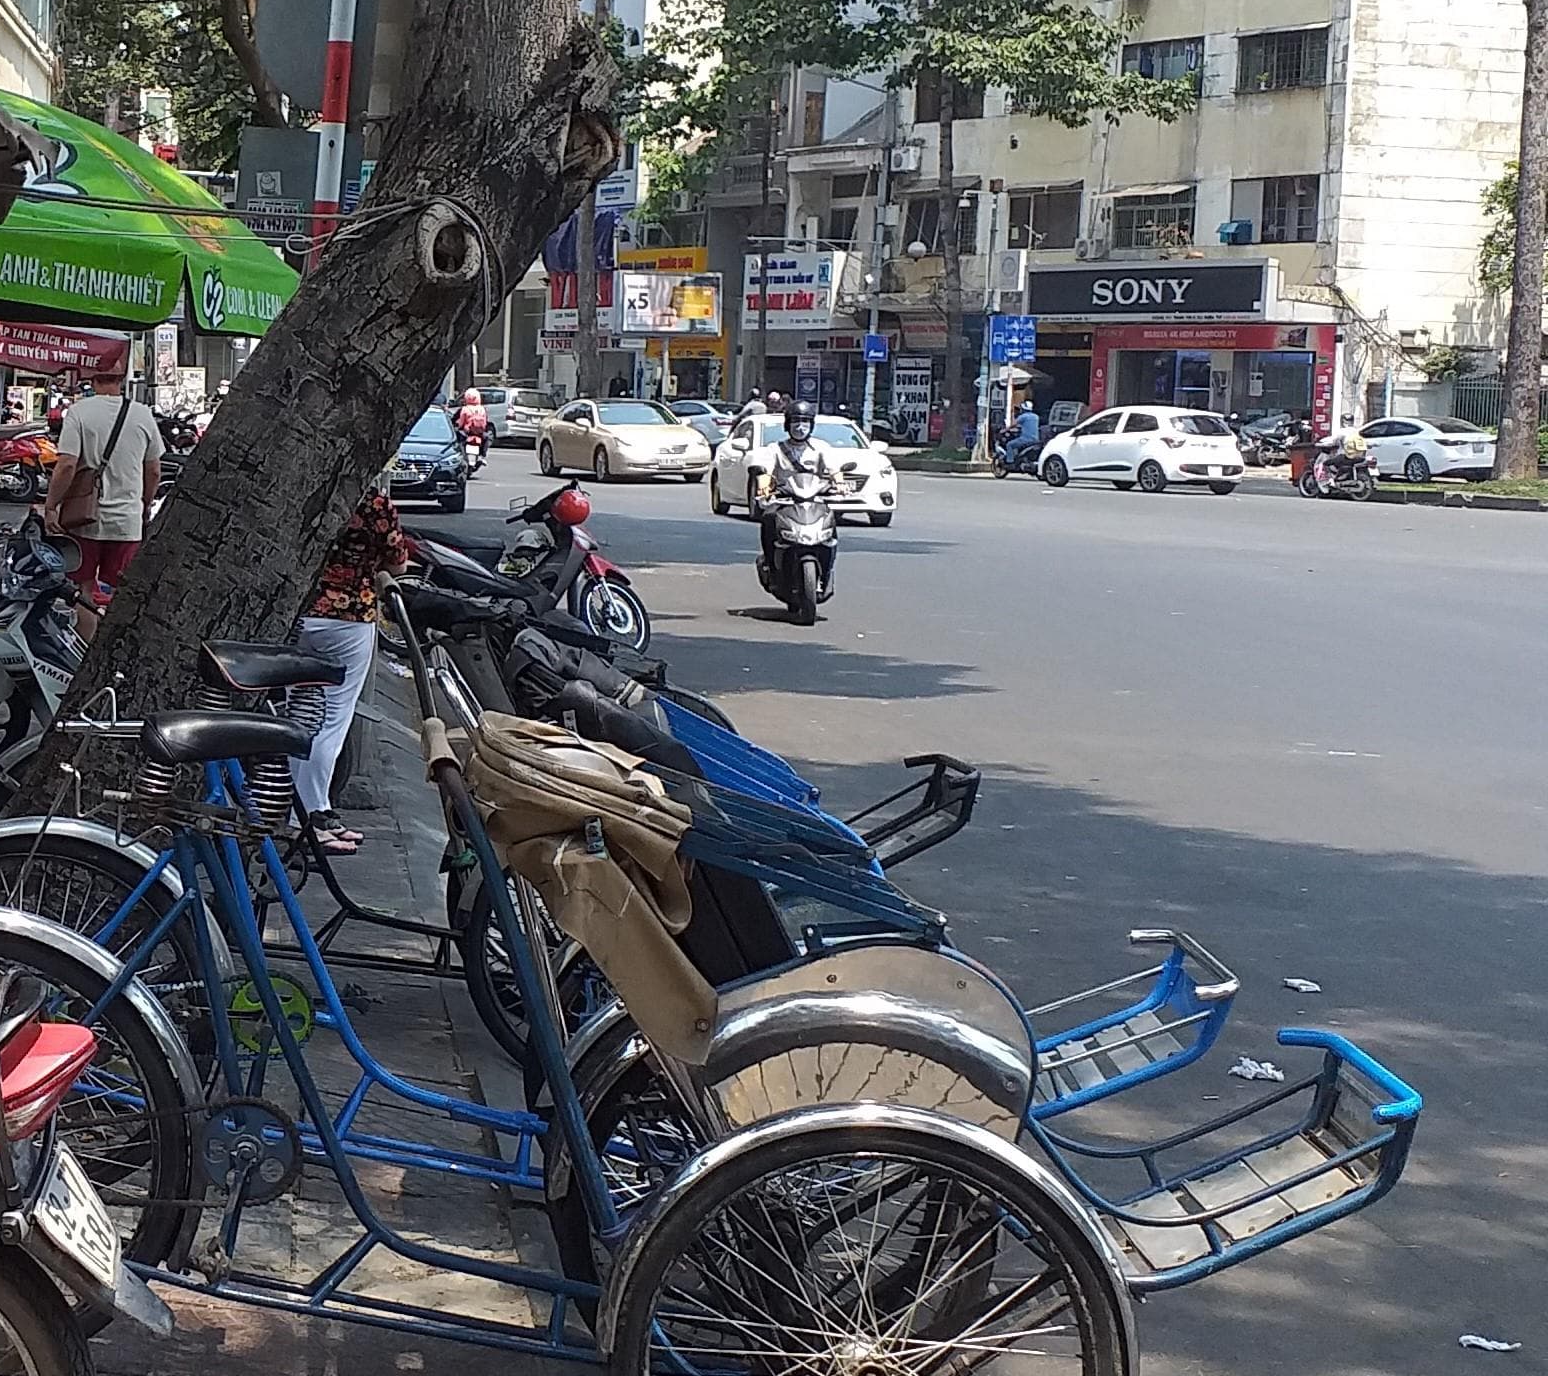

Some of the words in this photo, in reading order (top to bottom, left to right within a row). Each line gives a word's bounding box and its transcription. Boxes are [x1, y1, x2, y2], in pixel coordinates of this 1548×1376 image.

[52, 262, 113, 299] THANH
[1092, 278, 1192, 306] SONY
[204, 273, 225, 328] C2
[627, 292, 649, 310] x5
[1228, 330, 1238, 338] TV
